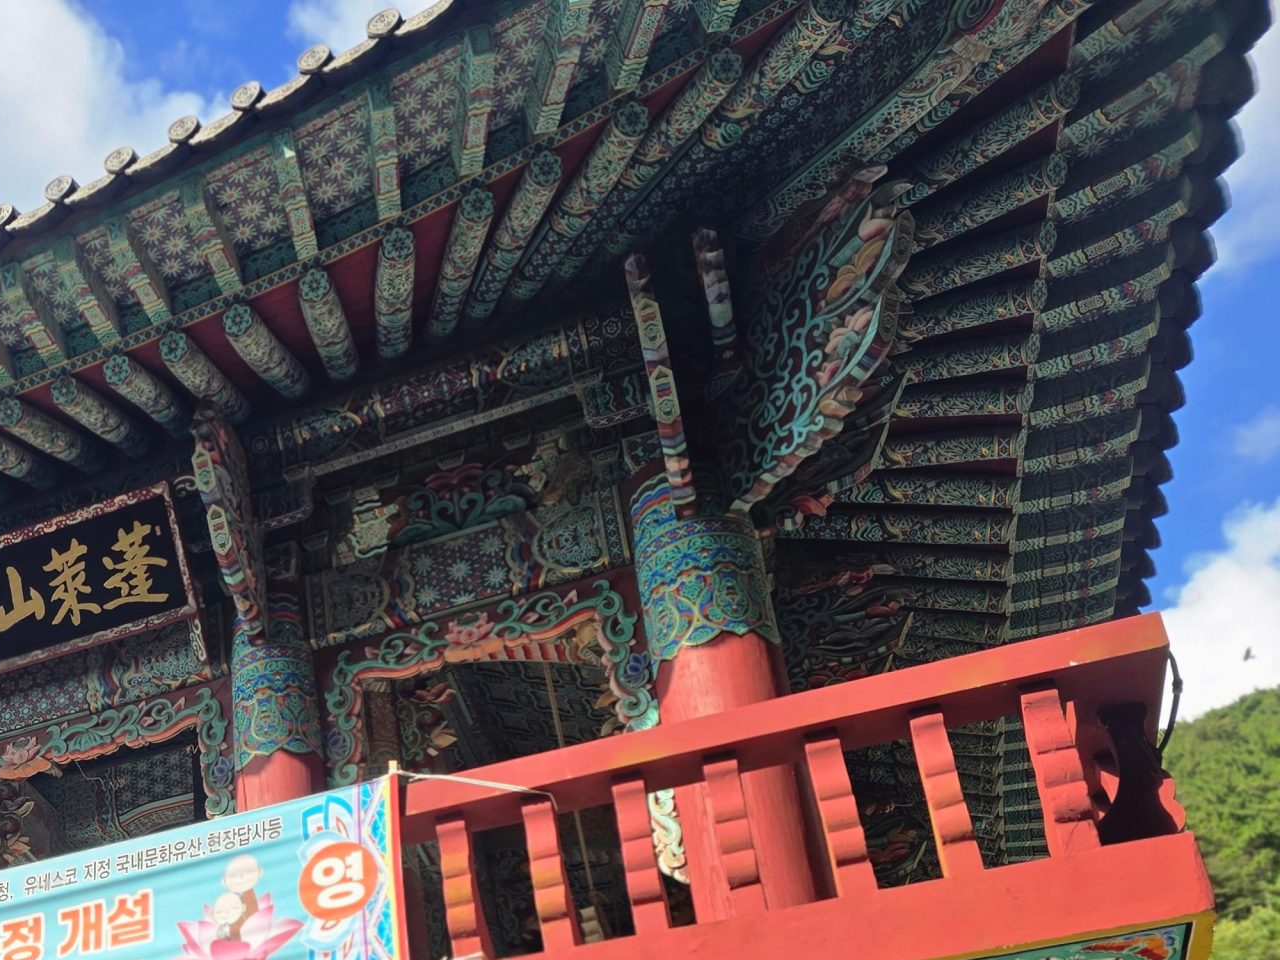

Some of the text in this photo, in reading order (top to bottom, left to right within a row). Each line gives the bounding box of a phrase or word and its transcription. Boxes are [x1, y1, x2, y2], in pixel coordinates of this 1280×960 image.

[24, 868, 78, 896] 유네스코
[83, 858, 111, 881] 지정
[311, 850, 366, 909] 영
[59, 892, 151, 956] 개설
